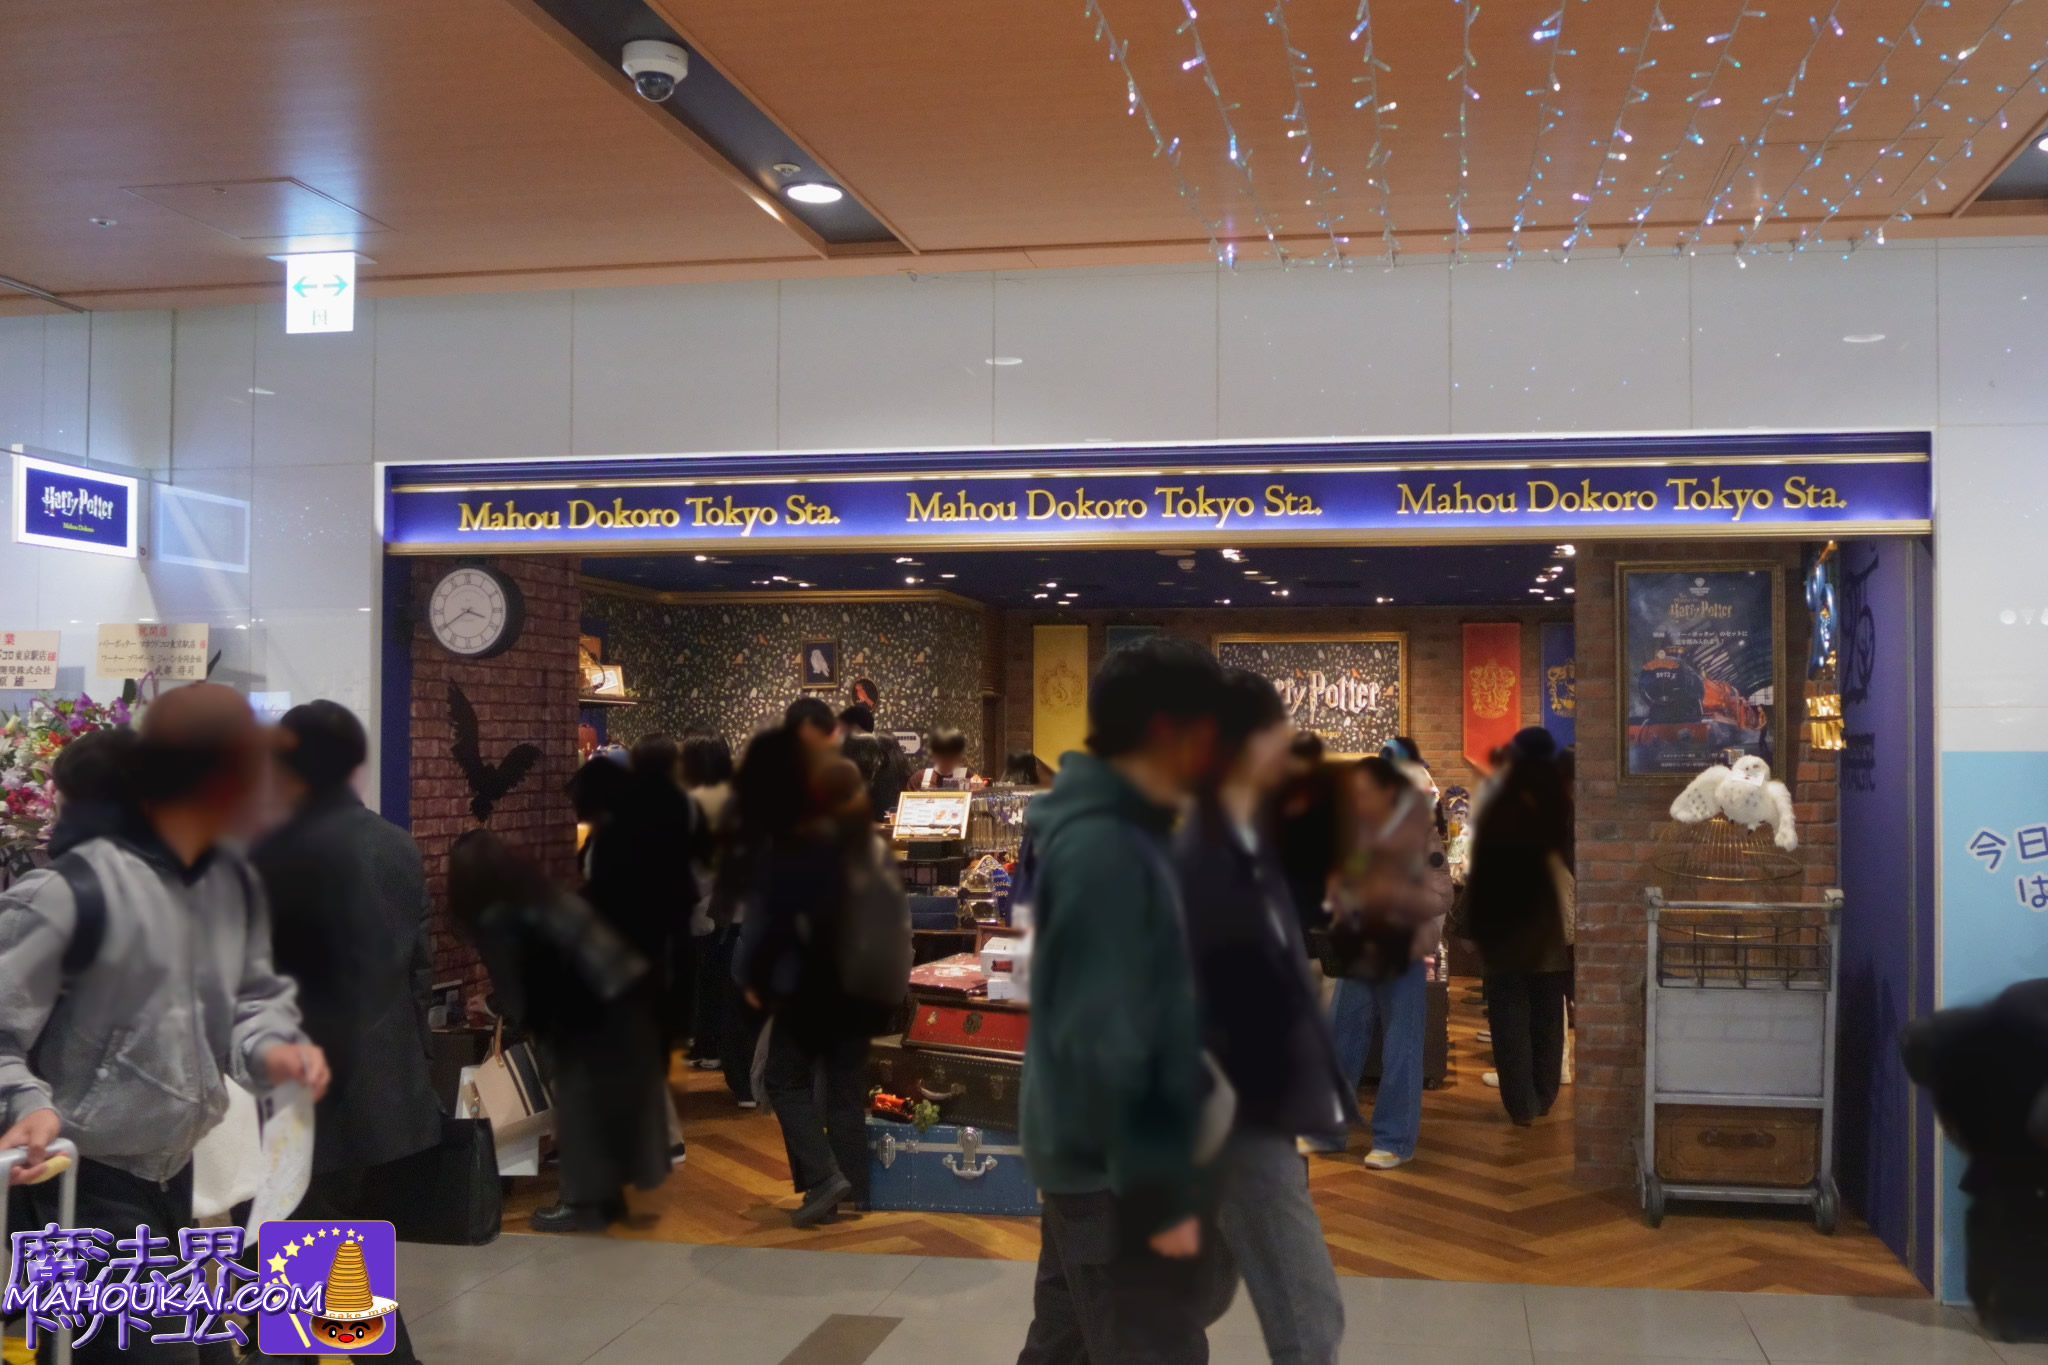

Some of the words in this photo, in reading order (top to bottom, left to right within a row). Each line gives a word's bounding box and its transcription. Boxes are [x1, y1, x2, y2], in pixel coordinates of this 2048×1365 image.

[41, 486, 79, 517] Harry
[78, 487, 114, 521] Potter
[458, 500, 561, 531] Mahou
[567, 497, 680, 528] Dokoro
[685, 495, 778, 537] Tokyo
[785, 494, 840, 525] Sta.
[906, 489, 1018, 522] Mahou
[1026, 487, 1147, 520] Dokoro
[1154, 485, 1254, 529] Tokyo
[1264, 484, 1322, 517] Sta.
[1397, 480, 1518, 515] Mahou
[1527, 478, 1657, 512] Dokoro
[1666, 476, 1773, 521] Tokyo
[1783, 475, 1847, 509] Sta.
[1700, 600, 1733, 619] Potter
[1308, 670, 1380, 725] Potter
[1969, 826, 2048, 870] 今日
